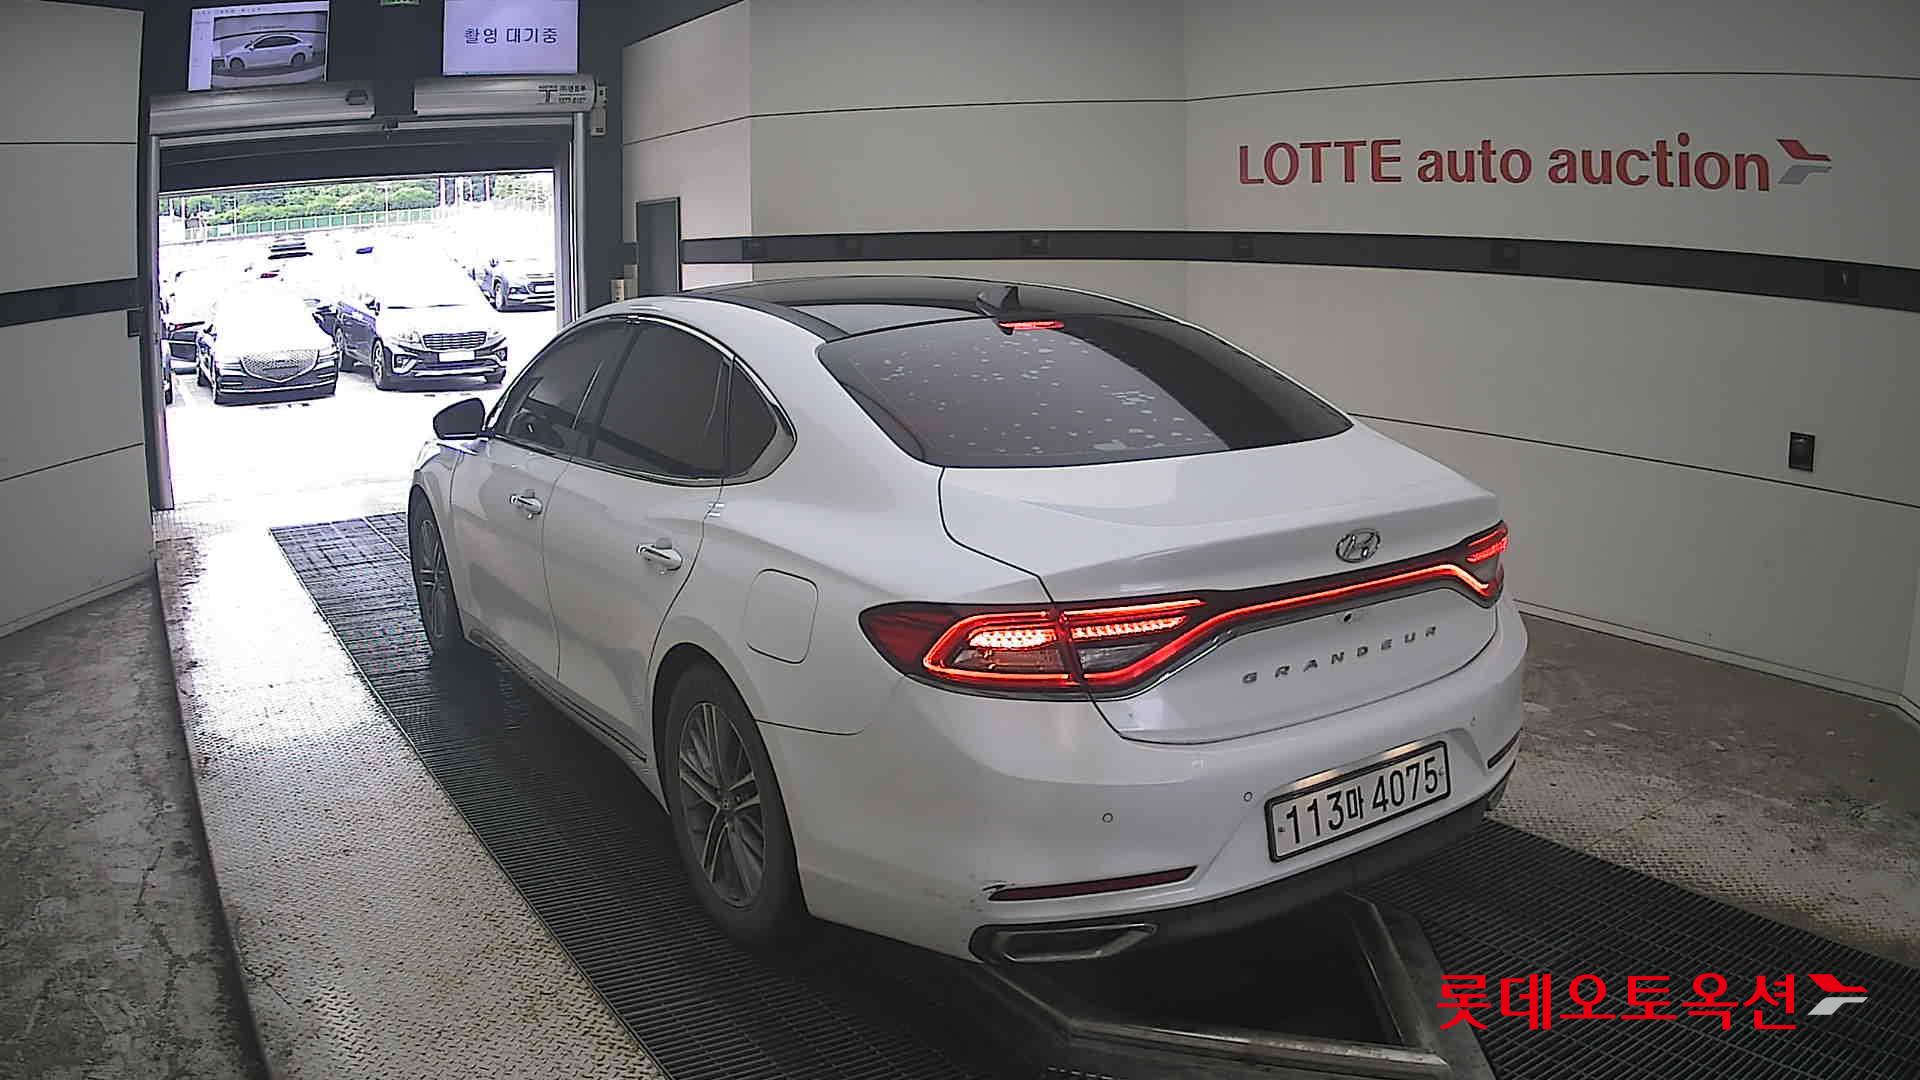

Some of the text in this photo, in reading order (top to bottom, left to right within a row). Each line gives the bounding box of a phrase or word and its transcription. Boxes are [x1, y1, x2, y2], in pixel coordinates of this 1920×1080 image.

[465, 27, 497, 45] 촬영
[1239, 132, 1770, 190] LOTTE auto auction
[1242, 626, 1437, 684] GRANDEUR
